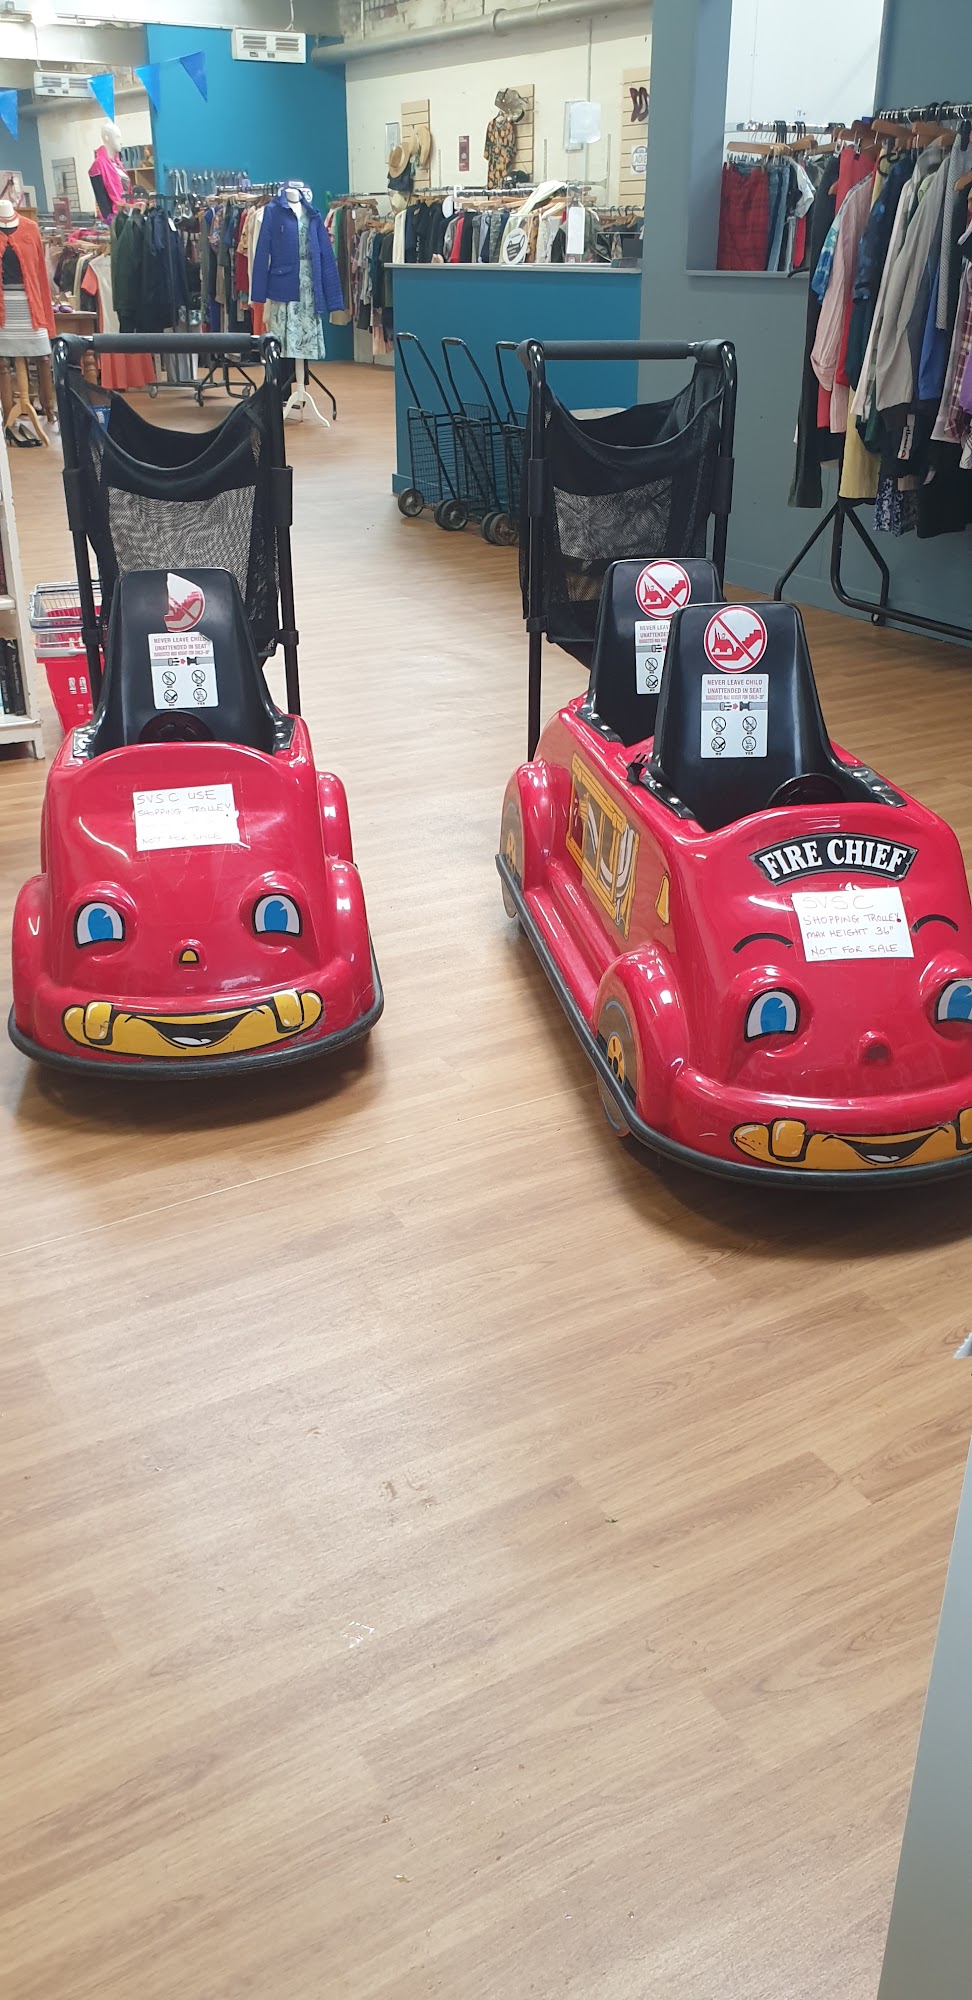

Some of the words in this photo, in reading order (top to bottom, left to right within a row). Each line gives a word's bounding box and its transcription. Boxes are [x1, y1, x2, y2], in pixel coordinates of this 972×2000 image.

[187, 789, 217, 801] USE
[759, 840, 823, 880] FIRE
[826, 838, 908, 873] CHIEF
[802, 914, 860, 926] SHOPPING
[806, 930, 826, 940] MAX
[829, 927, 868, 938] HEIGHT
[811, 945, 838, 957] NOT
[841, 945, 863, 954] FOR
[868, 943, 898, 954] SALE
